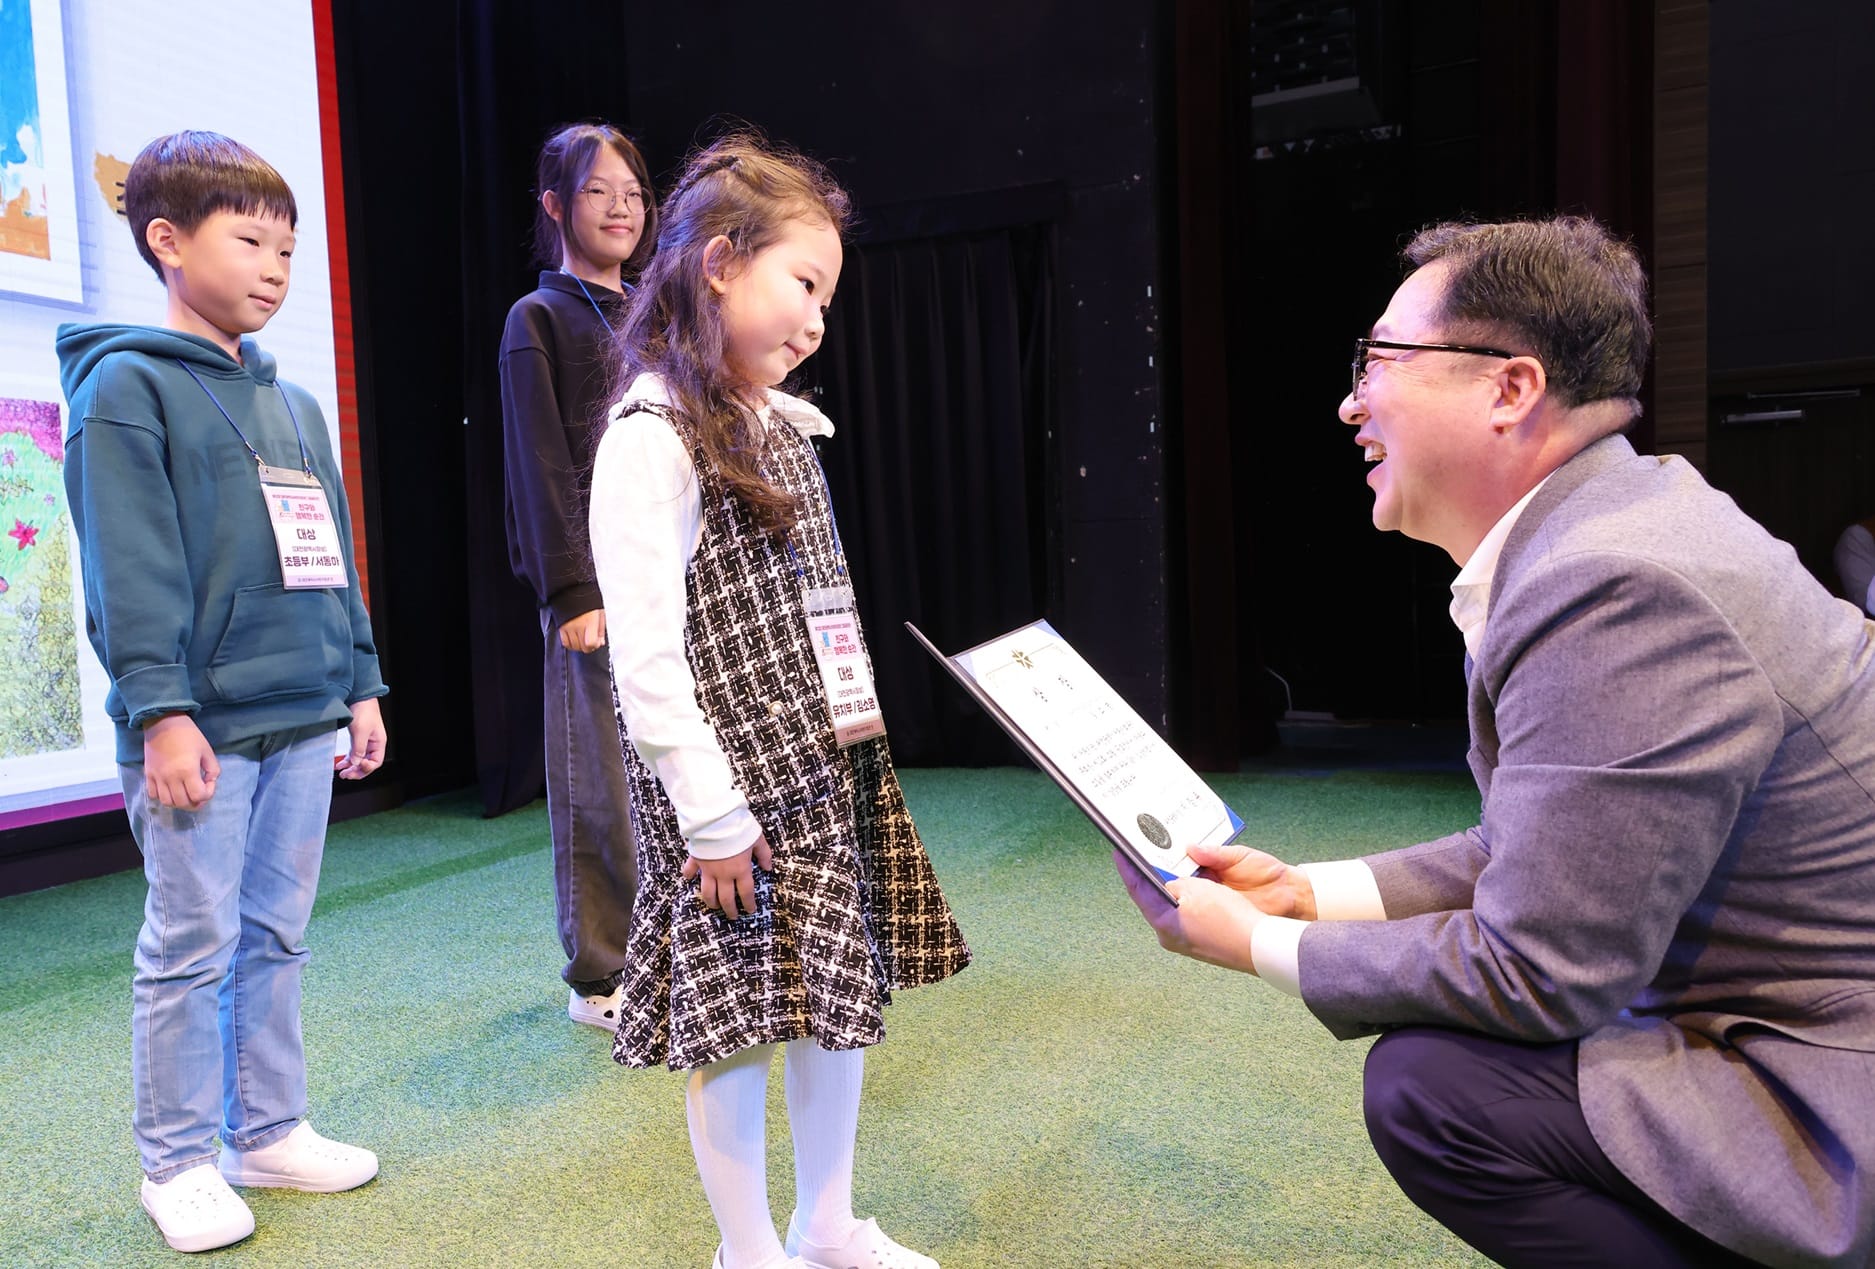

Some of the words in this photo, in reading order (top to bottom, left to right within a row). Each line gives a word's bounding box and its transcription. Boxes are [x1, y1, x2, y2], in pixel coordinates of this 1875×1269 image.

[296, 528, 316, 540] 대상
[284, 555, 310, 567] 초등부
[837, 666, 854, 681] 대상
[833, 702, 853, 718] 유치부
